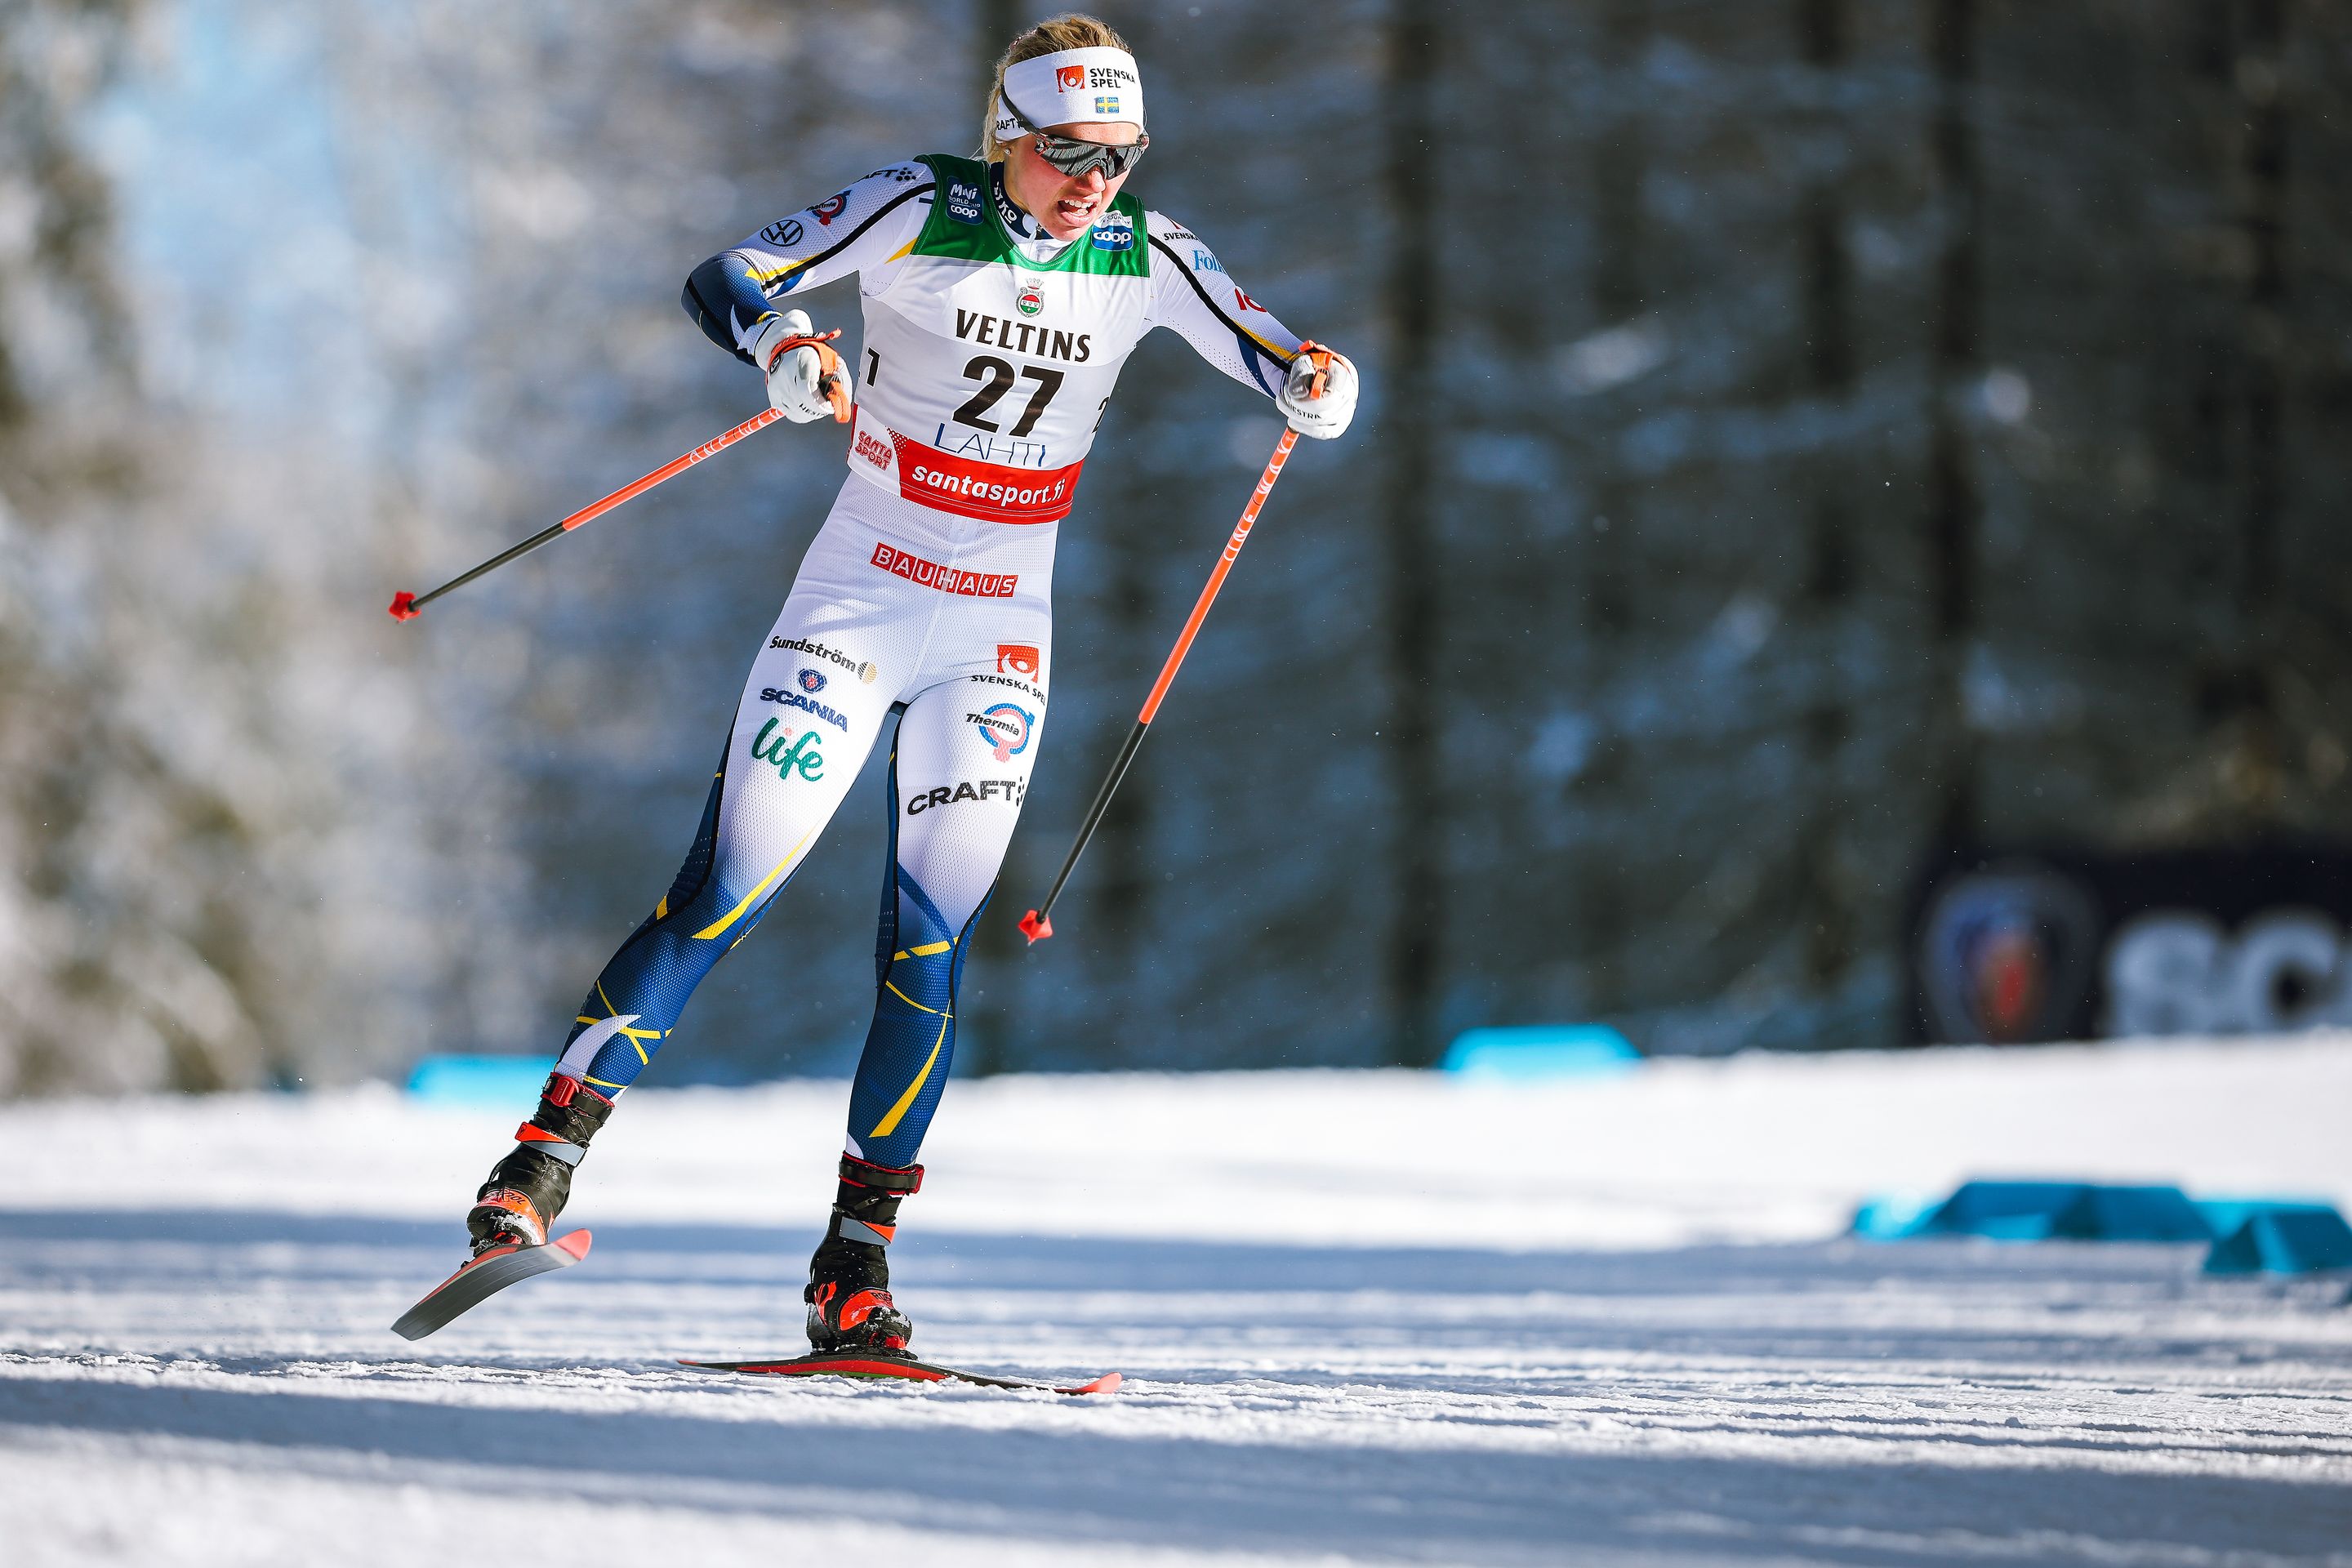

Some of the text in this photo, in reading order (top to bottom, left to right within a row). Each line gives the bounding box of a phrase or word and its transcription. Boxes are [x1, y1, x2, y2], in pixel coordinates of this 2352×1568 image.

[1089, 68, 1135, 84] SVENSKA
[1091, 78, 1121, 88] SPEL
[996, 118, 1015, 131] RAFT
[951, 205, 978, 218] coop
[1093, 231, 1132, 245] coop
[956, 308, 1091, 363] VELTINS
[951, 354, 1065, 438] 27
[1092, 395, 1110, 434] 2
[854, 442, 891, 471] SPORT
[858, 430, 893, 461] SANTA
[934, 422, 1046, 468] LAHTI
[911, 465, 1066, 507] santasport.fi
[873, 545, 1018, 596] BAUHAUS
[768, 635, 857, 673] Sundström
[970, 674, 1046, 707] SVENSKA SPEL
[760, 687, 849, 733] SCANIA
[965, 712, 1020, 737] Thermia
[751, 717, 824, 782] life
[906, 779, 1017, 816] CRAFT
